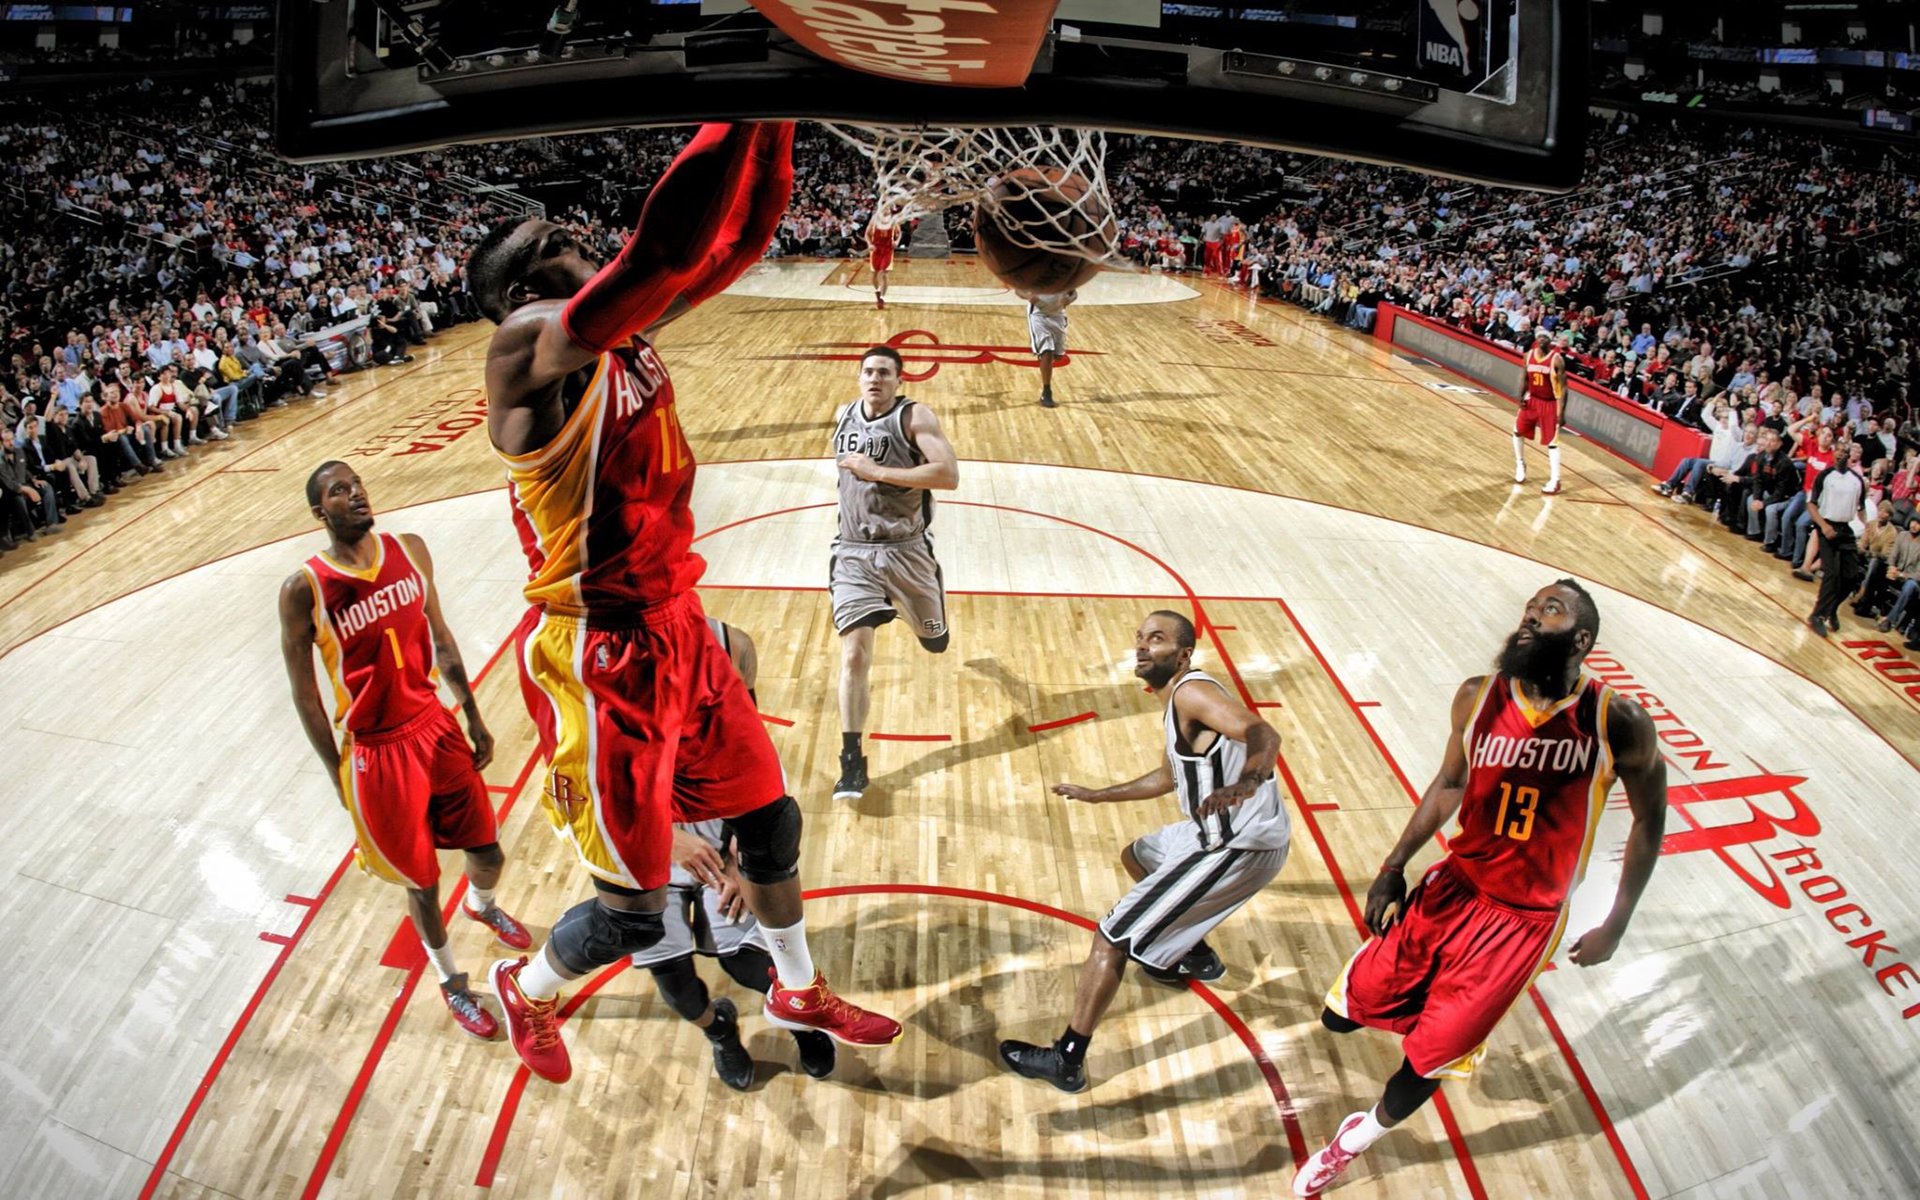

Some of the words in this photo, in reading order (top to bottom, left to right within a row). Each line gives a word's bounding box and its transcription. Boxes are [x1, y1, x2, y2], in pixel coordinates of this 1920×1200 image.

[1425, 41, 1461, 67] NBA
[1533, 373, 1544, 387] 31
[342, 389, 482, 458] CENTER
[391, 399, 488, 457] YOTA
[838, 432, 859, 455] 16
[1591, 405, 1626, 446] TIME
[335, 573, 421, 641] HOUSTON
[384, 627, 404, 670] 1
[1841, 640, 1920, 703] RO
[1472, 732, 1593, 774] HOUSTON
[1494, 781, 1540, 842] 13
